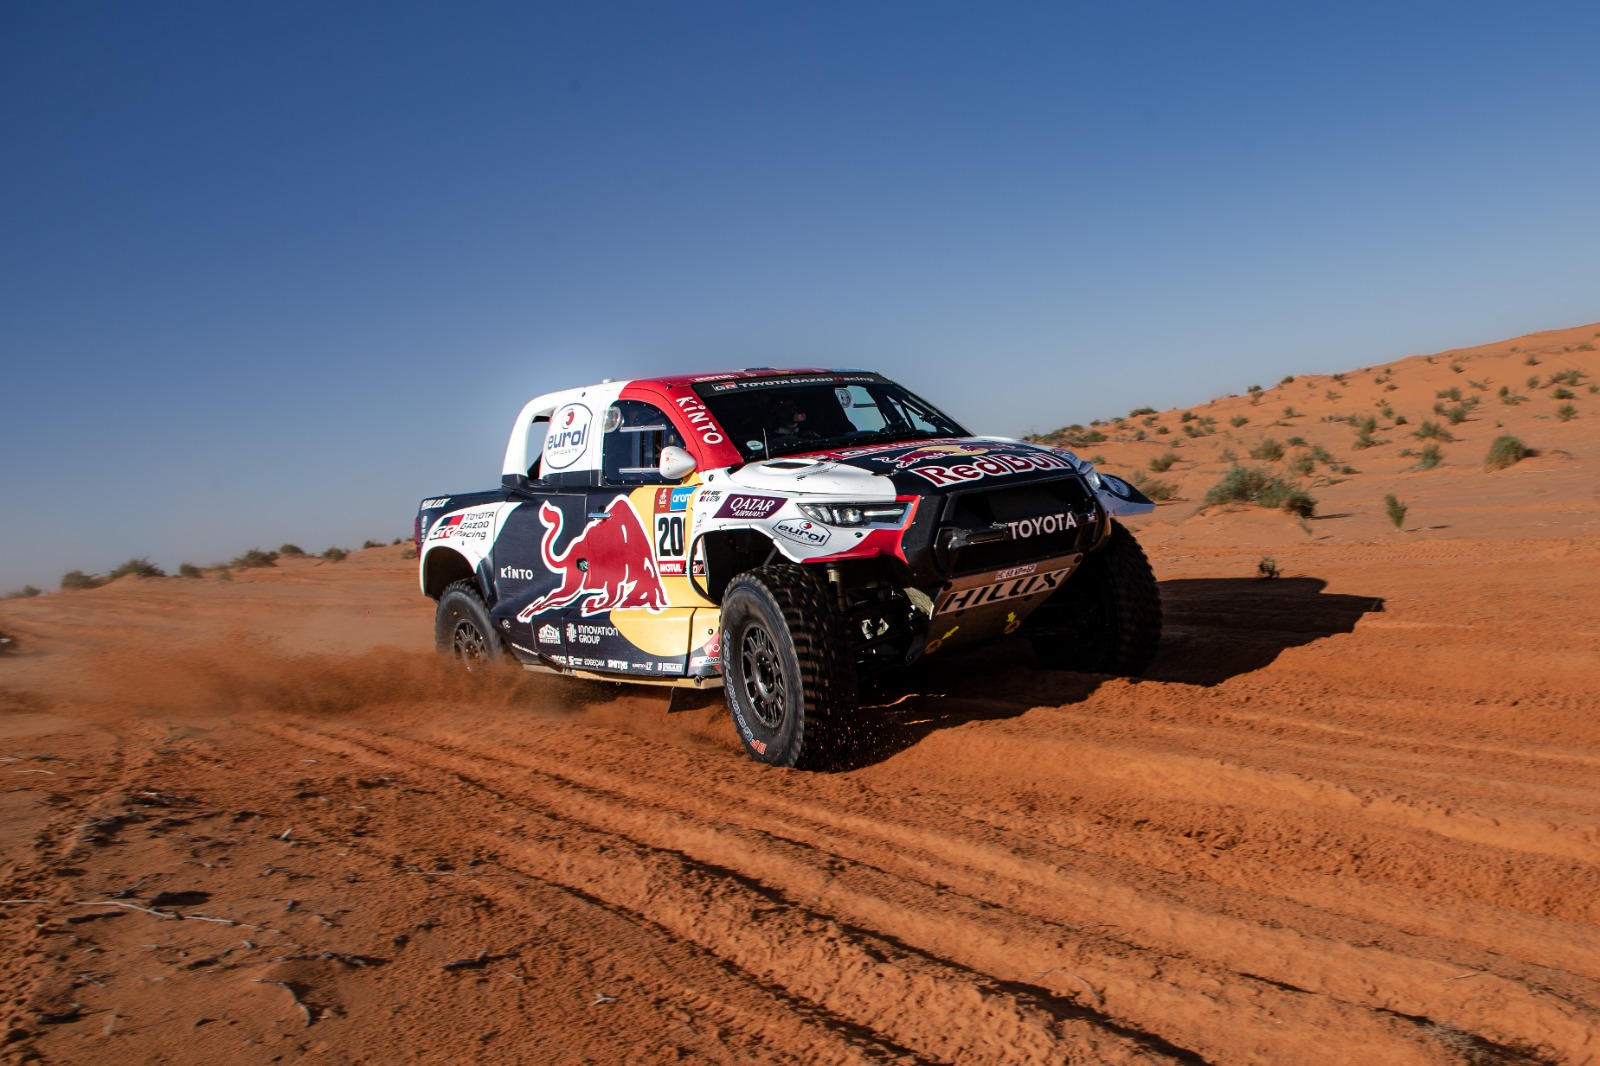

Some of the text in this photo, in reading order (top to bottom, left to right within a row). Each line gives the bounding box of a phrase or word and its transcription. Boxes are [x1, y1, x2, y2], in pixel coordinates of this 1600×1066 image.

[547, 423, 587, 450] eurol
[730, 497, 775, 512] QATAR
[732, 509, 767, 517] AIRWAYS
[465, 511, 495, 521] TOYOTA
[777, 524, 826, 543] eurol
[1008, 511, 1077, 539] TOYOTA
[658, 516, 686, 557] 20
[660, 563, 682, 573] MOTUL
[940, 569, 1064, 612] HILUX
[578, 635, 600, 645] GROUP
